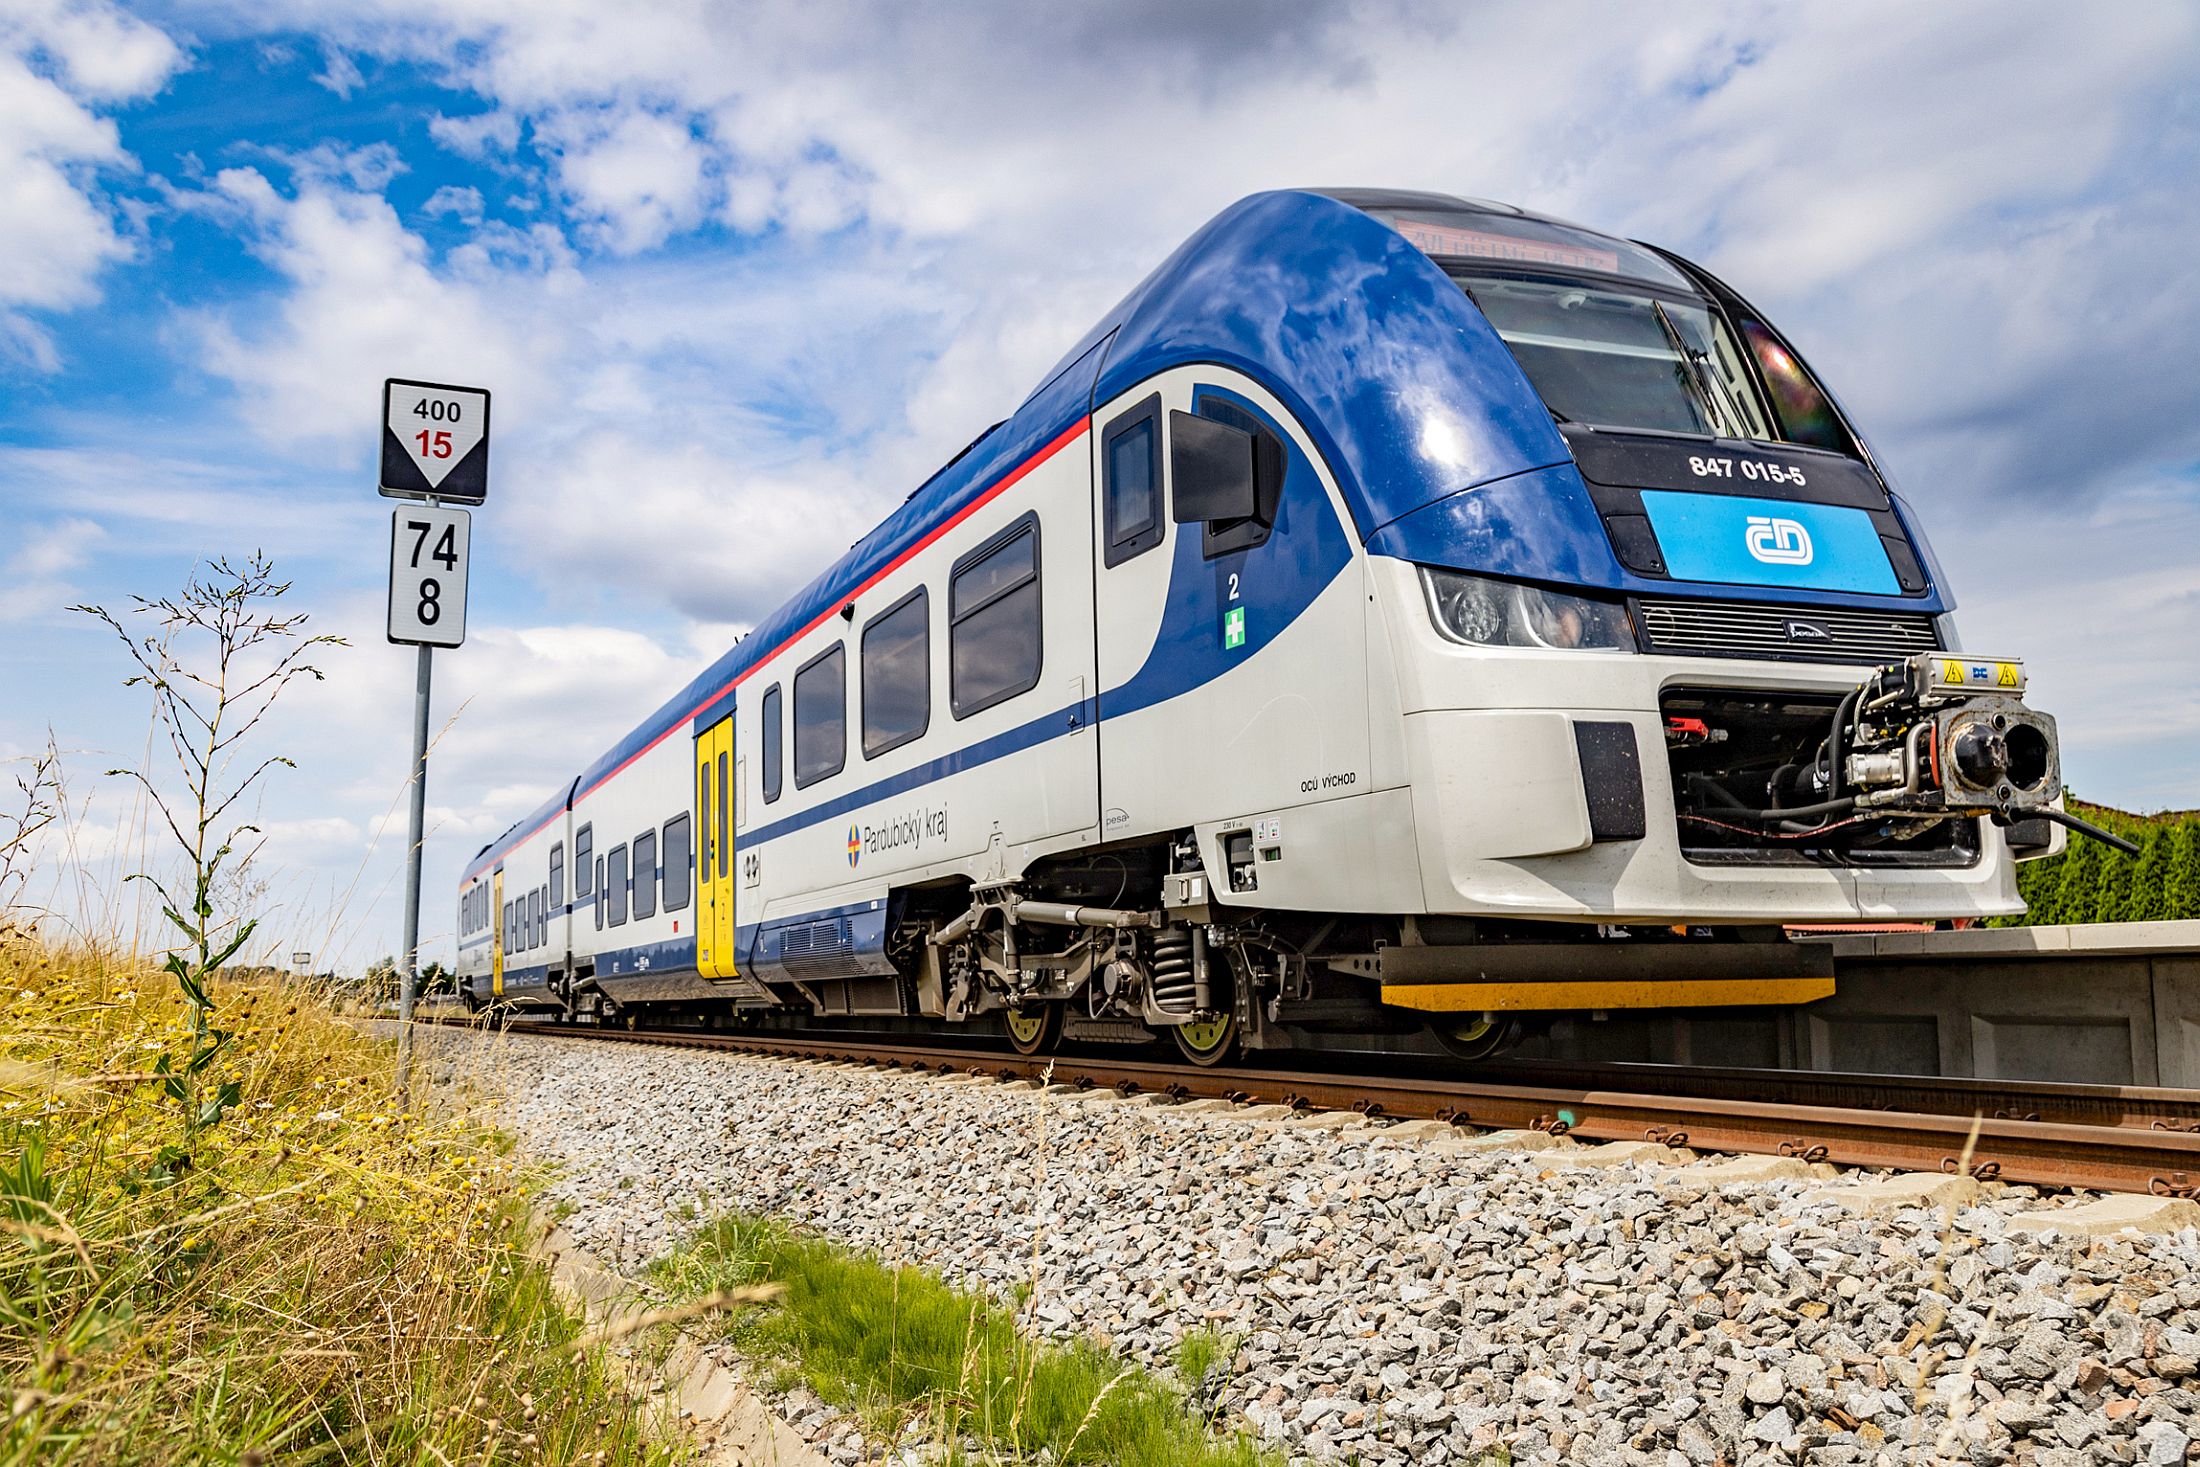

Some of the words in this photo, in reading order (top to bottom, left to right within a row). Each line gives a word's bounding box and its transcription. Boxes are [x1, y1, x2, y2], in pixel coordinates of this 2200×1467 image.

[413, 398, 461, 422] 400
[415, 429, 452, 459] 15
[1688, 456, 1733, 477] 847
[1740, 460, 1806, 486] 015-5
[407, 520, 458, 571] 74
[417, 577, 440, 626] 8
[1229, 573, 1239, 600] 2
[1301, 776, 1318, 792] OCÚ
[1322, 772, 1356, 789] VÝCHOD
[864, 809, 921, 855] Pardubický
[926, 801, 948, 843] kraj
[1106, 814, 1127, 827] pesa
